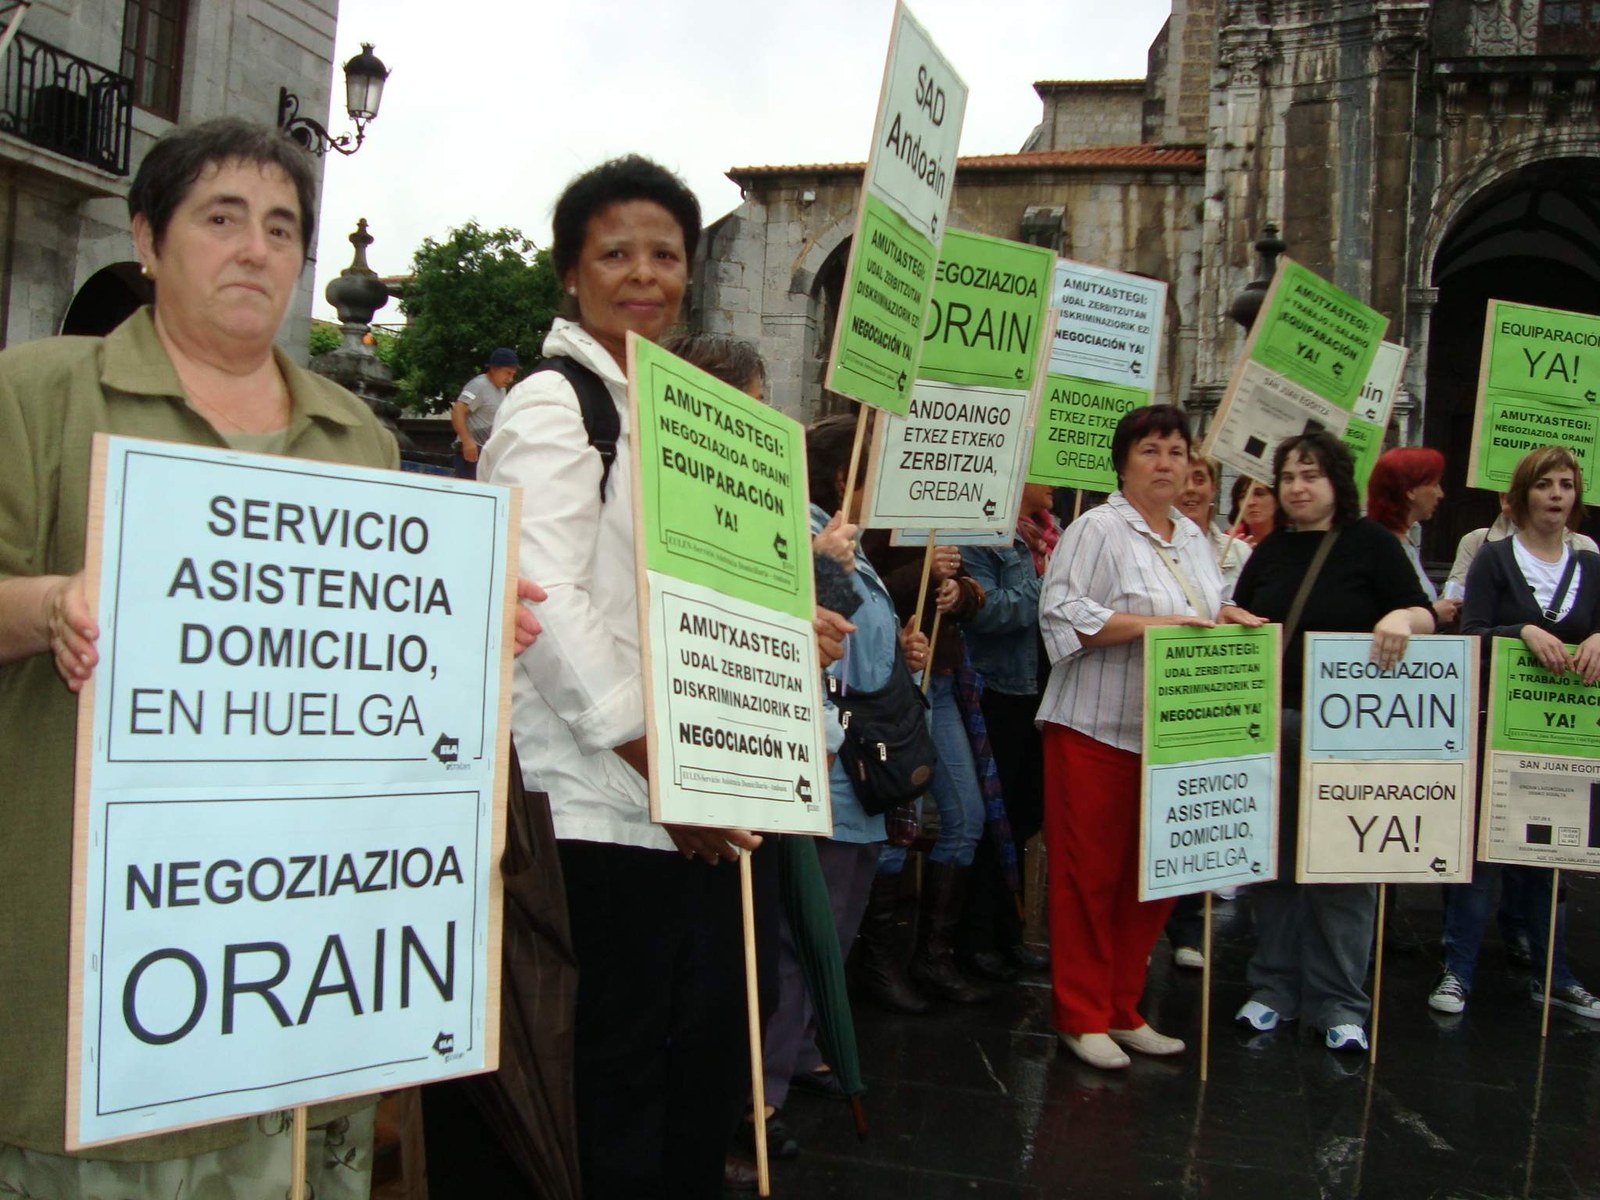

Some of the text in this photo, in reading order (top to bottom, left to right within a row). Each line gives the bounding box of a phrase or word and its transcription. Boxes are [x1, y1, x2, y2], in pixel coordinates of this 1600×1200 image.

[915, 65, 946, 127] SAD
[886, 112, 946, 199] Andoain
[866, 258, 883, 281] UDAL
[935, 260, 1038, 299] EGOZIAZIOA
[1063, 278, 1148, 305] AMUTXASTEGI:
[1060, 309, 1136, 331] ISKRIMINAZIORIK
[1062, 295, 1147, 319] UDAL ZERBITZUTAN
[851, 315, 901, 356] NEGOCIACIÓN
[1054, 329, 1145, 354] NEGOCIACIÓN YA!
[1501, 322, 1600, 348] EQUIPARACIÓ
[1296, 341, 1321, 364] YA!
[1523, 348, 1580, 384] YA!
[909, 399, 1011, 425] ANDOAINGO
[1050, 388, 1135, 414] ANDOAINGO
[664, 384, 784, 459] AMUTXASTEGI:
[1049, 409, 1118, 430] ETXEZ ETXE
[1494, 424, 1559, 439] NEGOZIAZIOA
[1500, 410, 1592, 430] AMUTXASTEGI:
[904, 427, 1005, 448] ETXEZ ETXEKO
[660, 415, 790, 489] NEGOZIAZIOA ORAIN!
[900, 451, 997, 476] ZERBITZUA,
[662, 446, 785, 516] EQUIPARACIÓN
[909, 480, 983, 502] GREBAN
[207, 495, 430, 555] SERVICIO
[714, 504, 739, 533] YA!
[167, 557, 453, 616] ASISTENCIA
[180, 622, 438, 680] DOMICILIO,
[680, 612, 801, 663] AMUTXASTEGI:
[1165, 643, 1260, 659] AMUTXASTEGI:
[680, 649, 803, 693] UDAL ZERBITZUTAN
[1165, 663, 1261, 679] UDAL ZERBITZUTAN
[1519, 673, 1571, 686] TRABAJO
[673, 678, 812, 722] DISKRIMINAZIORIK EZ!
[1158, 680, 1250, 696] DISKRIMINAZIORIK
[130, 688, 425, 736] EN HUELGA
[1160, 702, 1262, 723] NEGOCIACIÓN YA!
[1320, 693, 1456, 729] ORAIN
[1543, 712, 1576, 728] YA!
[679, 722, 810, 763] NEGOCIACIÓN YA!
[1519, 759, 1540, 770] SAN
[1542, 761, 1569, 772] JUAN
[1177, 772, 1249, 797] SERVICIO
[1318, 780, 1457, 802] EQUIPARACIÓN
[1166, 796, 1258, 824] ASISTENCIA
[1170, 821, 1254, 849] DOMICILIO,
[1347, 814, 1422, 853] YA!
[1155, 846, 1249, 879] EN HUELGA
[125, 845, 465, 911] NEGOZIAZIOA
[122, 920, 457, 1046] ORAIN
